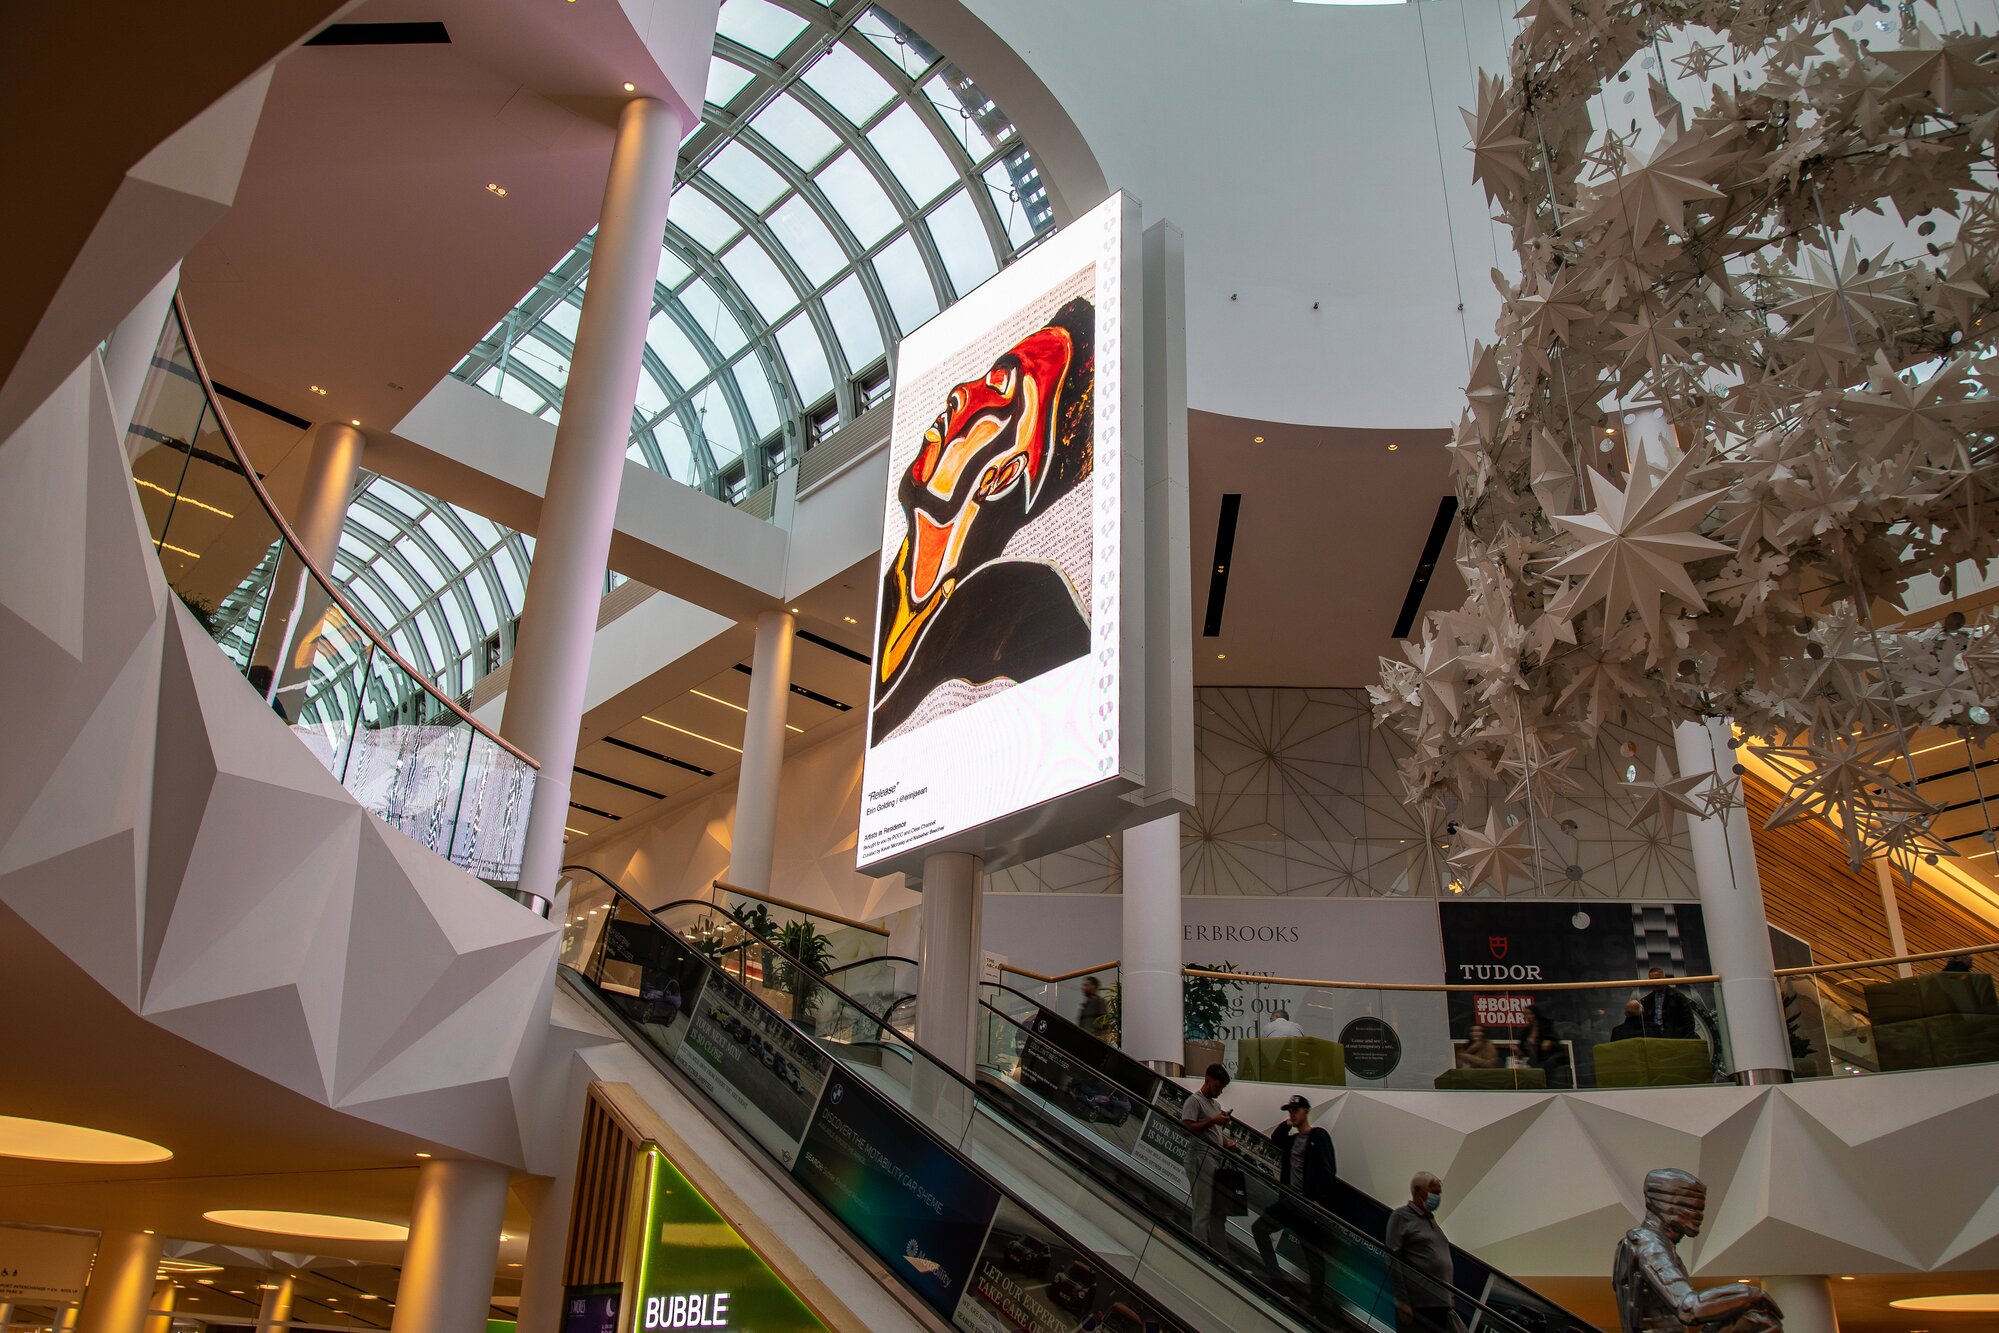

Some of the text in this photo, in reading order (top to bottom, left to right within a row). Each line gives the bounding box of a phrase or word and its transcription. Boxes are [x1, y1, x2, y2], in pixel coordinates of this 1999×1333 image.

[877, 800, 895, 812] Golding
[864, 831, 878, 841] Artists
[883, 821, 907, 834] Residence
[1459, 964, 1543, 980] TUDOR
[1251, 998, 1291, 1014] our
[696, 1015, 743, 1062] YOUR NEXT MINI
[1147, 1129, 1187, 1159] IS SO CLOSE
[1152, 1119, 1190, 1148] YOUR NEXT
[822, 1108, 853, 1138] DISCOVER
[852, 1130, 866, 1150] THE
[864, 1144, 905, 1181] MOTABILITY
[902, 1174, 918, 1193] CAR
[645, 1293, 730, 1328] BUBBLE
[978, 1276, 1003, 1305] TAKE
[1001, 1299, 1029, 1327] CARE
[983, 1260, 1003, 1284] LET
[1001, 1276, 1023, 1302] OUR
[1022, 1294, 1067, 1333] EXPERTS
